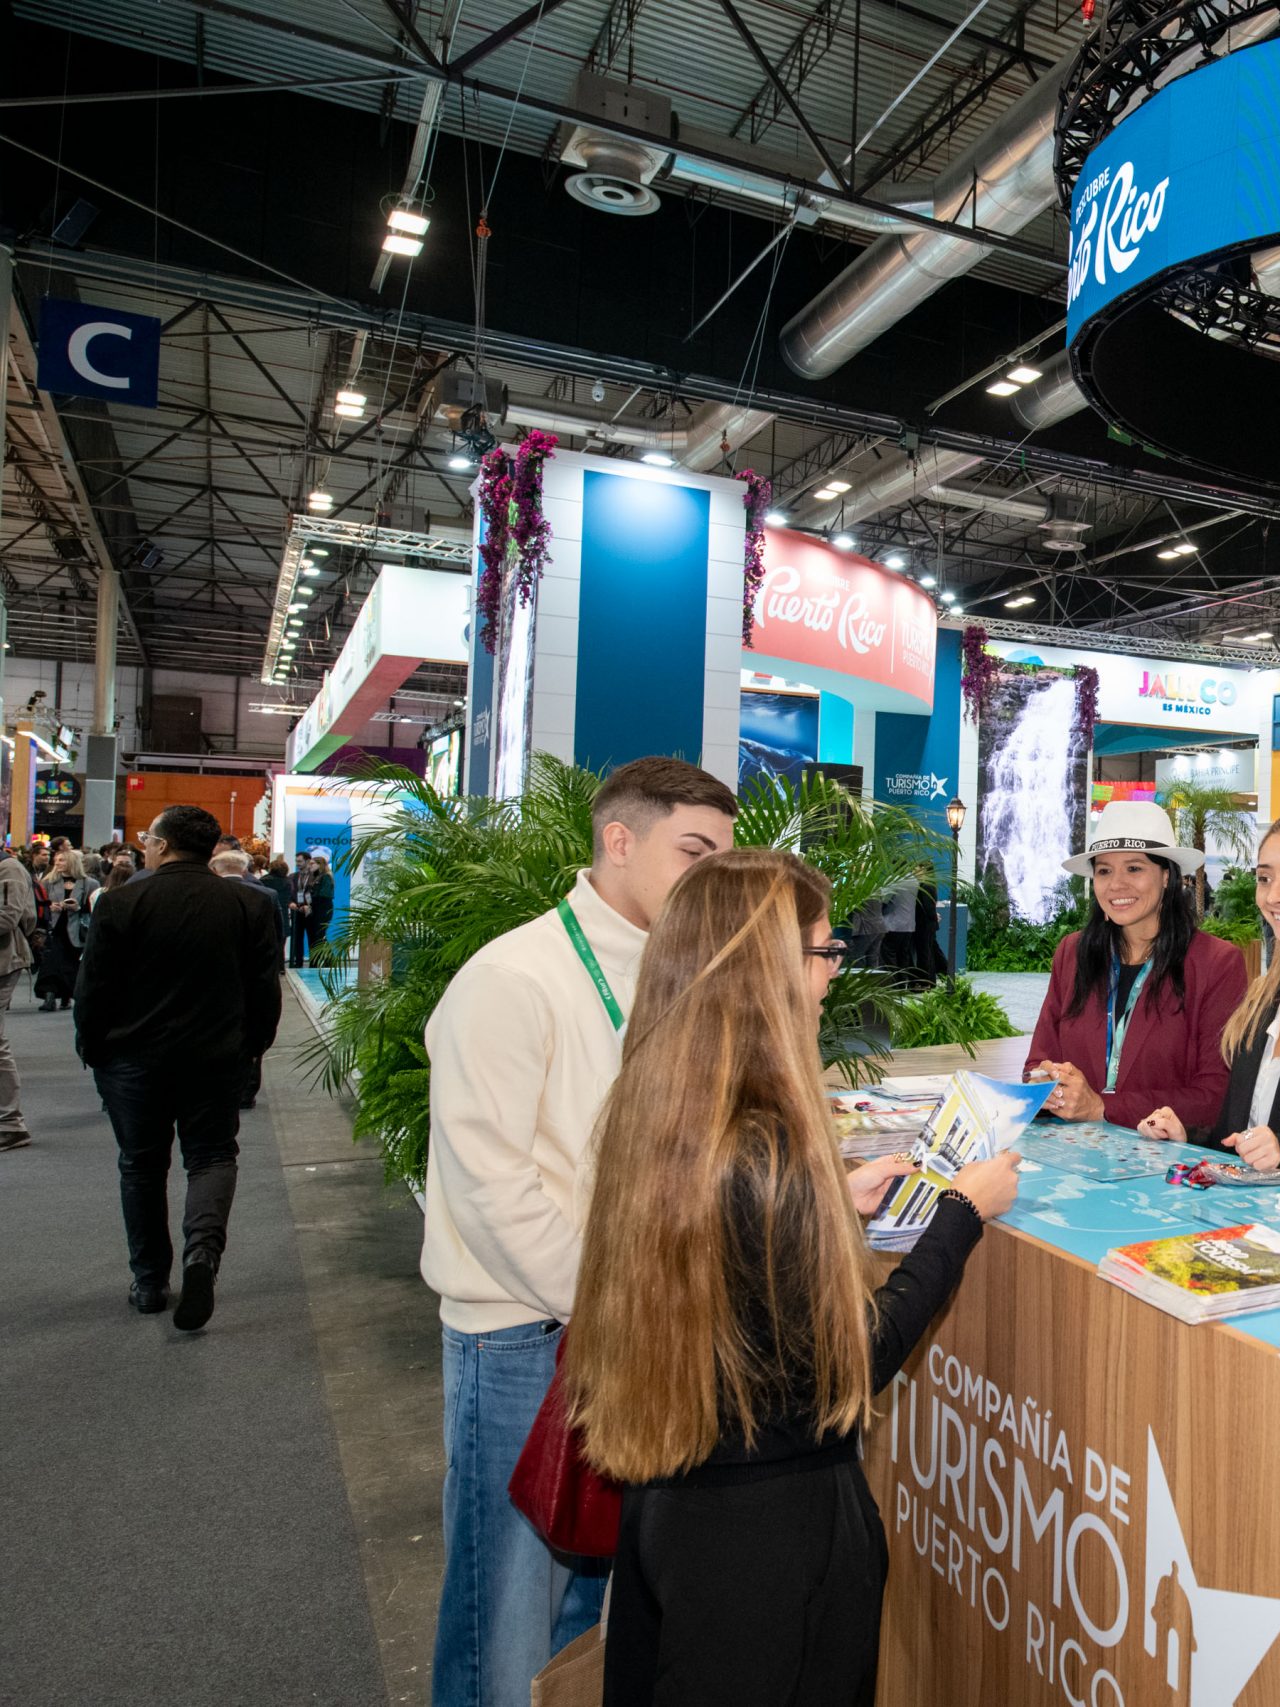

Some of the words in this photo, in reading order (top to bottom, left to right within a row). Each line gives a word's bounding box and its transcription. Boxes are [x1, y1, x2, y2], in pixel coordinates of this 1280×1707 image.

[1095, 161, 1170, 285] Rico
[68, 321, 132, 389] C
[753, 565, 841, 632] Puerto
[837, 592, 888, 655] Rico
[1138, 671, 1237, 706] JALCO
[1162, 703, 1173, 712] ES
[1175, 704, 1211, 715] MÉXICO
[885, 777, 931, 790] TURISMO
[1092, 839, 1120, 851] PUERTO
[1123, 839, 1146, 849] RICO
[929, 1343, 1074, 1486] COMPAÑÍA
[1085, 1445, 1131, 1526] DE
[891, 1369, 1129, 1648] TURISMO
[897, 1481, 1010, 1632] PUERTO
